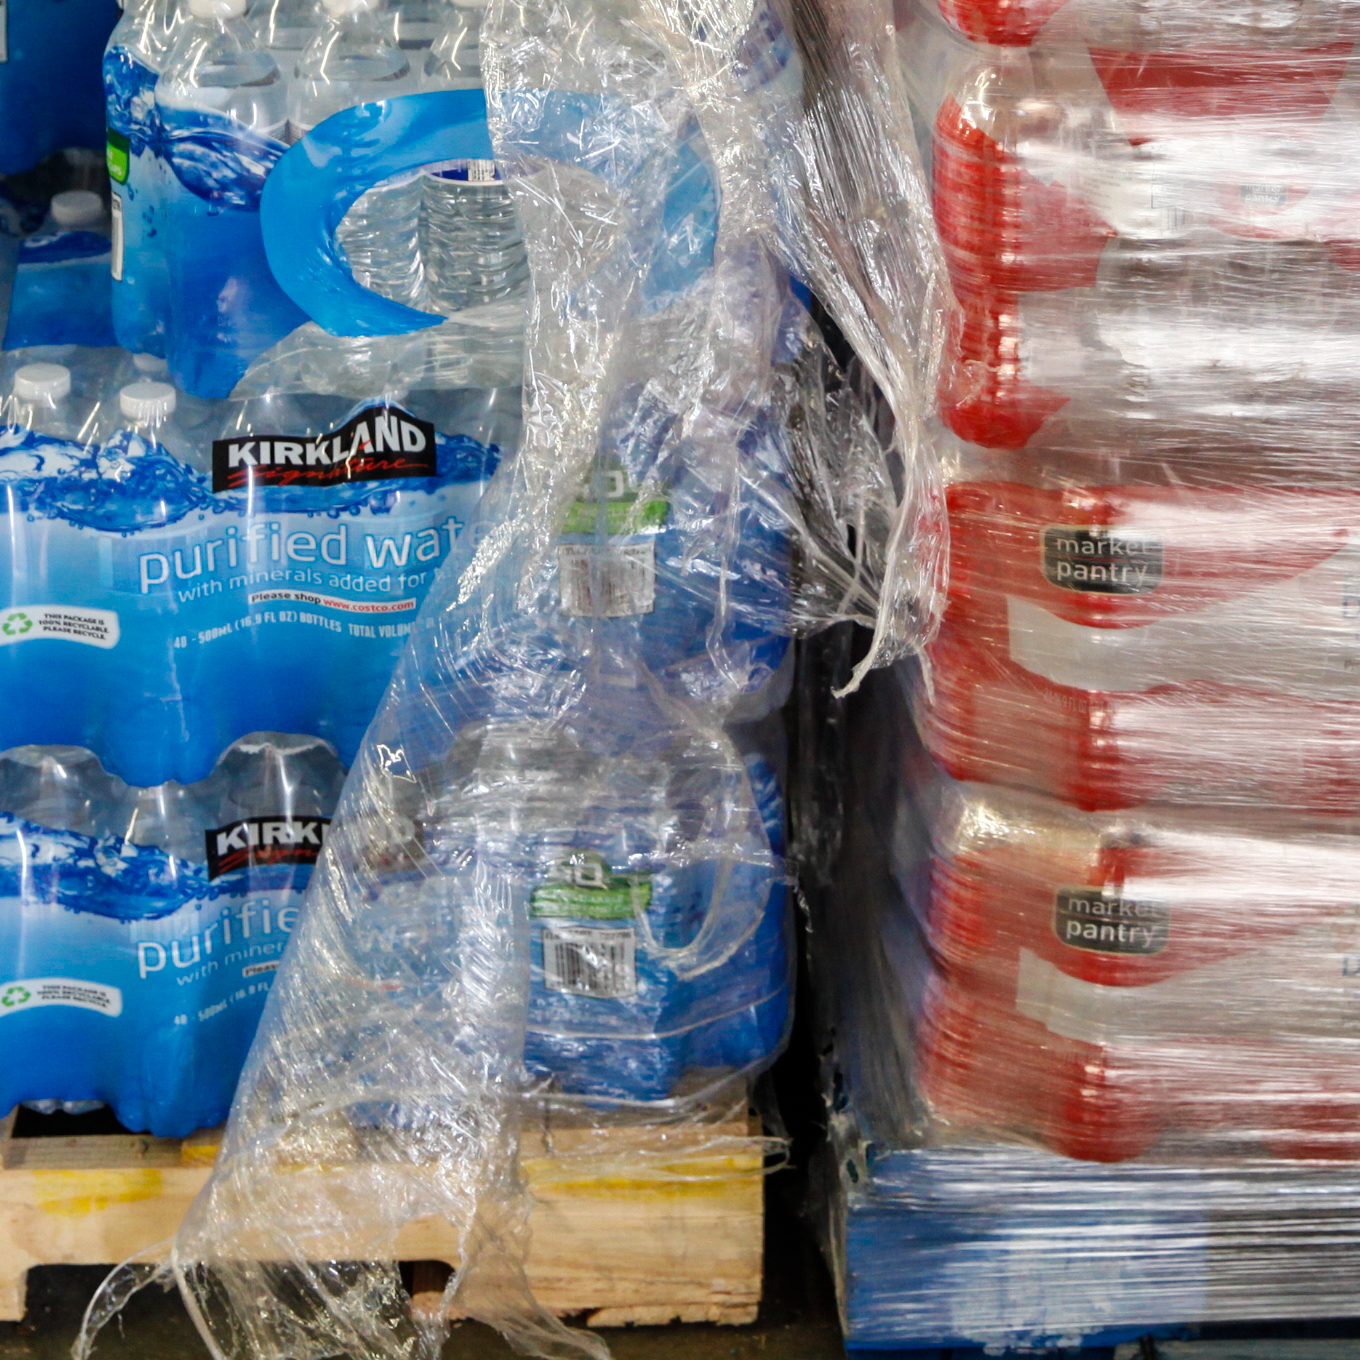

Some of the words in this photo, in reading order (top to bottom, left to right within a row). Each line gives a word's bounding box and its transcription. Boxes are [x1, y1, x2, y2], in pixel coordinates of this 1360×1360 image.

[228, 416, 428, 468] KIRKLAND
[226, 455, 429, 488] Signature
[140, 516, 347, 594] purified
[178, 578, 223, 603] with
[229, 567, 323, 590] minerals
[329, 571, 391, 592] added
[398, 570, 426, 590] for
[1056, 560, 1148, 587] pantry
[63, 614, 97, 624] PACKAGE
[252, 592, 291, 603] Please
[294, 593, 321, 605] shop
[323, 598, 415, 612] www.costco.com
[43, 626, 72, 634] PLEASE
[174, 635, 188, 649] 40
[235, 613, 262, 630] (16.9
[264, 611, 277, 624] FL
[279, 610, 298, 623] OZ)
[299, 612, 342, 633] BOTTLES
[348, 622, 376, 638] TOTAL
[378, 622, 415, 638] VOLUM
[138, 900, 300, 978] purifie
[1065, 918, 1158, 953] pantry
[176, 960, 219, 986] with
[224, 942, 284, 965] miner
[245, 963, 280, 977] Pleas
